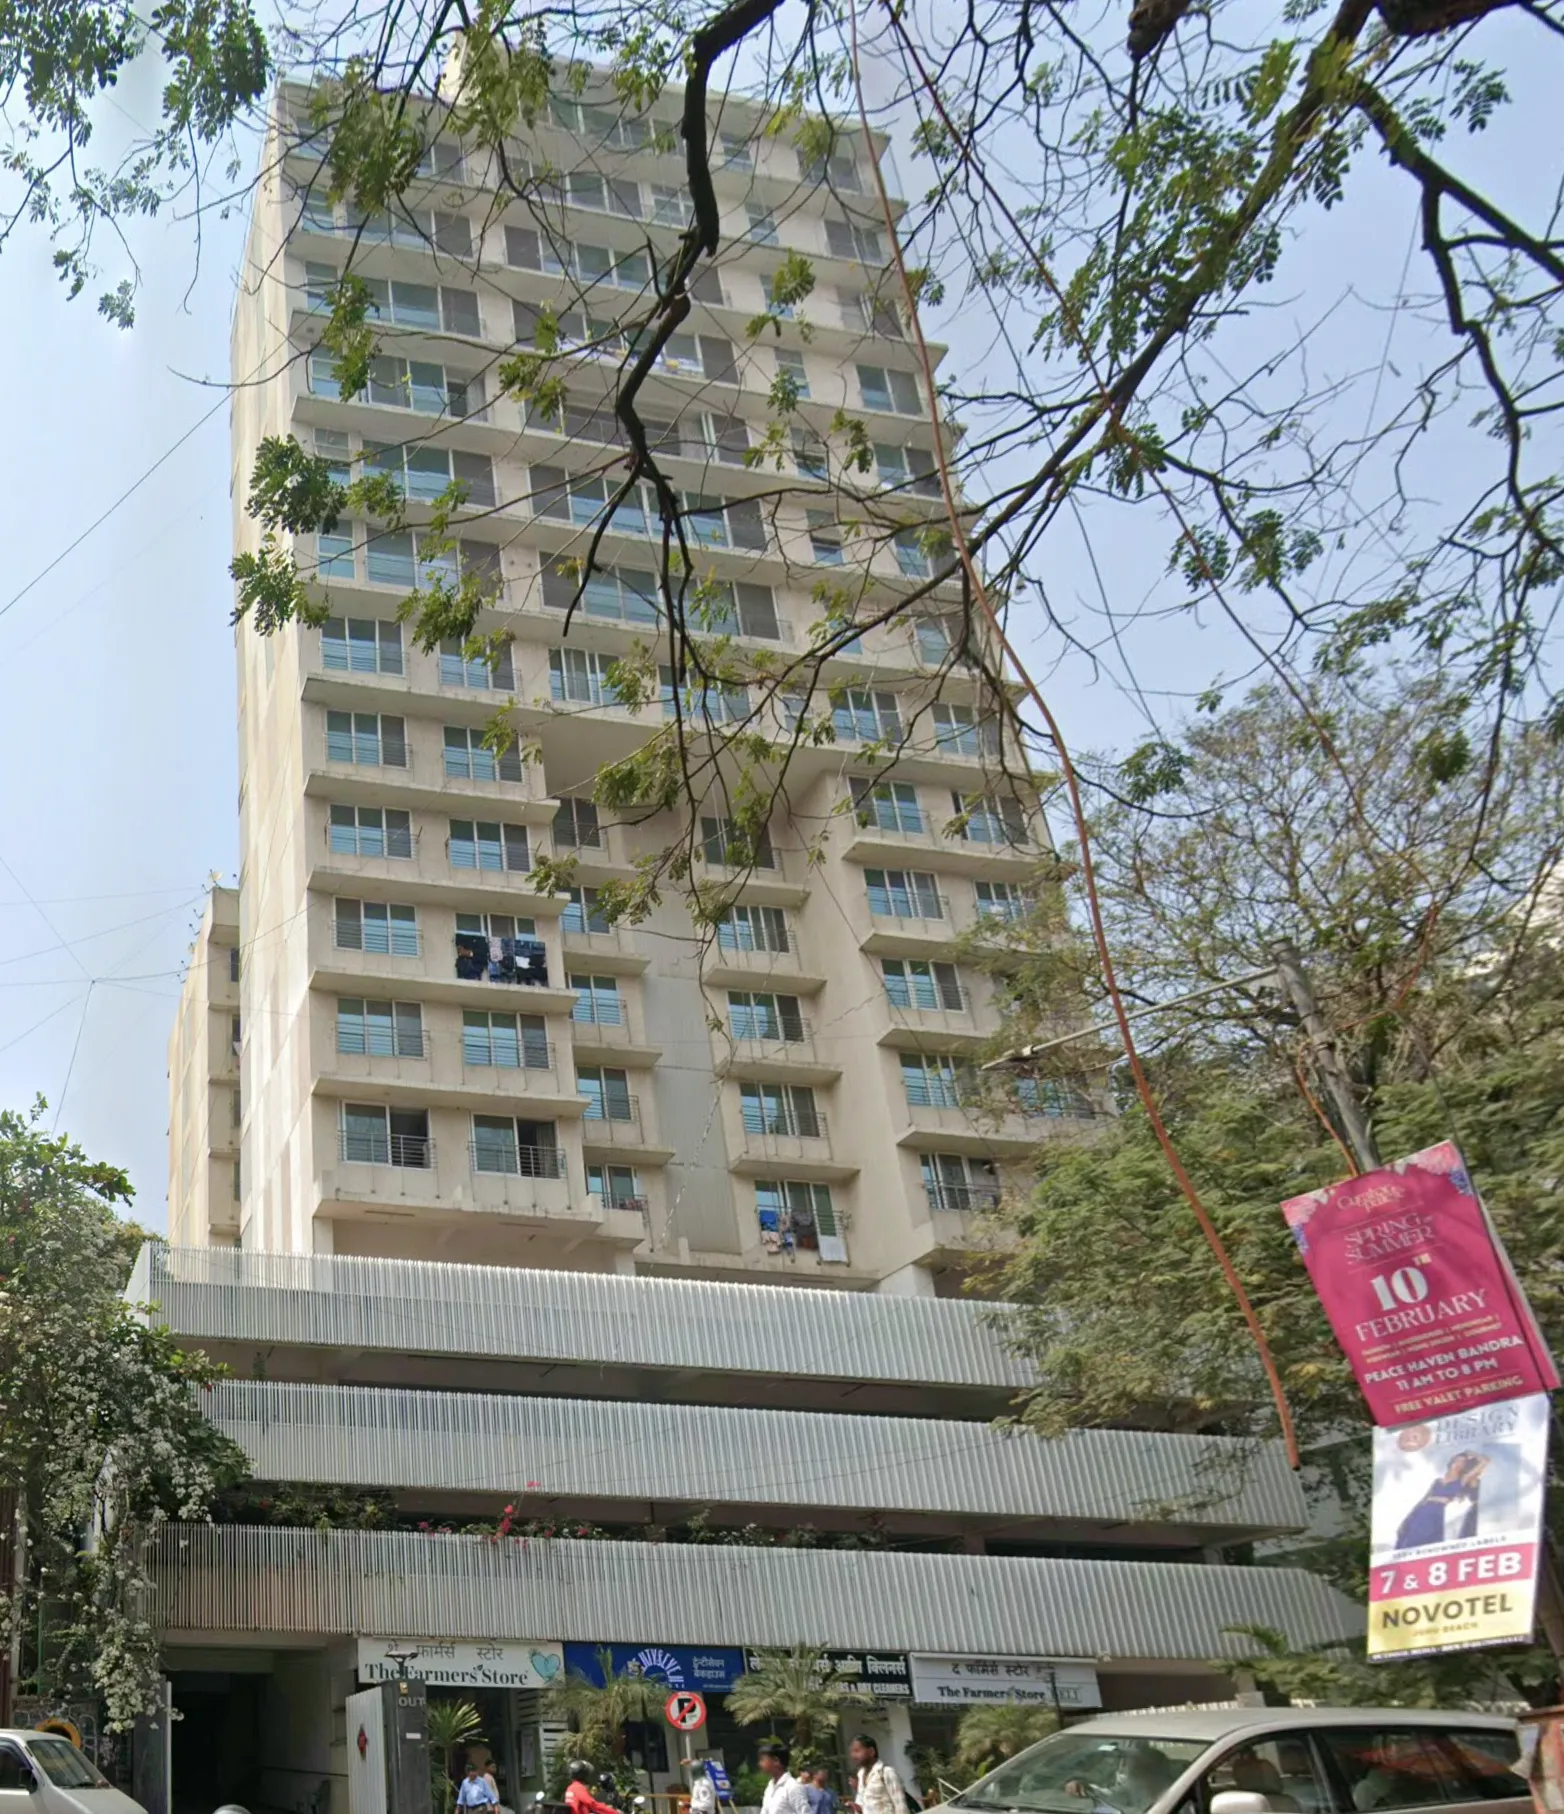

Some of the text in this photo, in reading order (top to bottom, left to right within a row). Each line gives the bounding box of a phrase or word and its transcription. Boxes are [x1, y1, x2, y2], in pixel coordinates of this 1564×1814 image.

[1355, 1288, 1487, 1342] FEBRUARY
[1364, 1365, 1405, 1384] PEACE
[1407, 1352, 1454, 1373] HAVEN
[1458, 1335, 1525, 1360] BANDRA
[1396, 1357, 1499, 1391] 11 AM TO 8 PM
[1393, 1374, 1524, 1414] FREE VALET PARKING
[1380, 1552, 1522, 1594] 7 & 8 FEB
[1382, 1593, 1513, 1629] NOVOTEL
[476, 1643, 504, 1661] स्टोर
[365, 1663, 399, 1680] The
[481, 1668, 528, 1686] Store
[398, 1696, 425, 1707] OUT
[937, 1686, 961, 1697] The
[1015, 1688, 1045, 1700] Store
